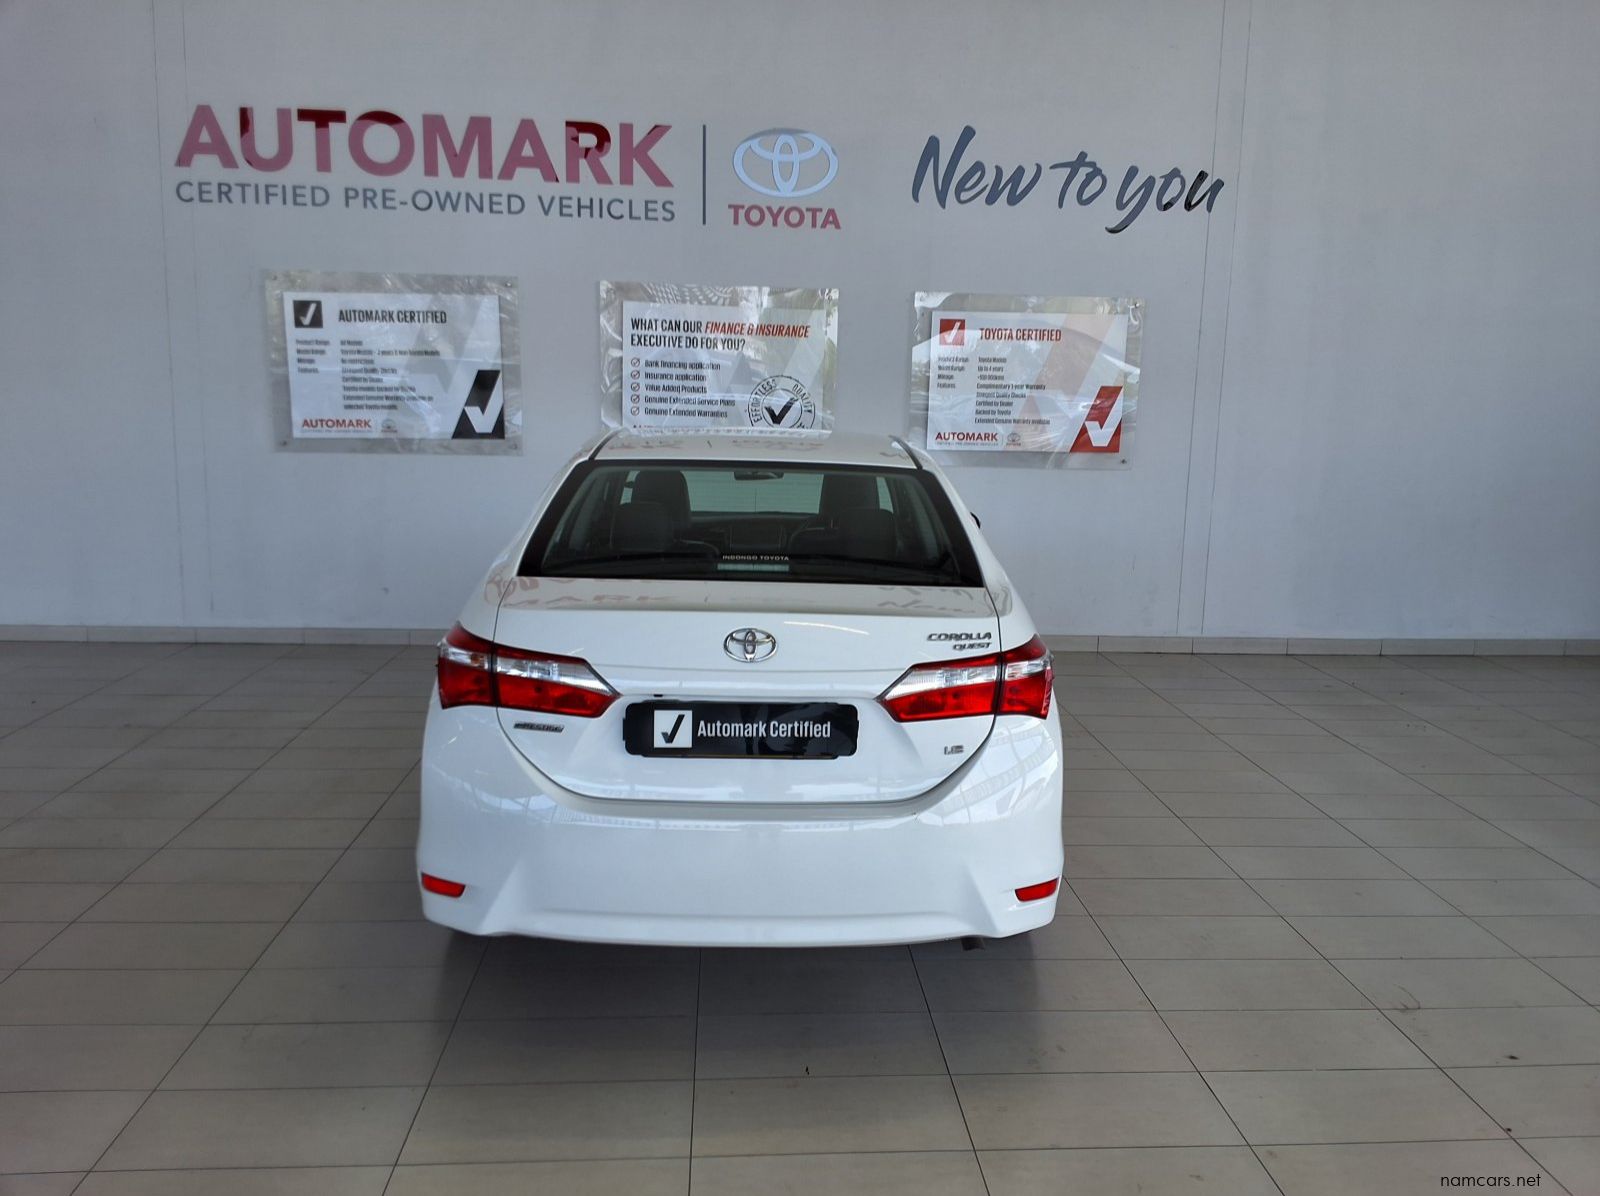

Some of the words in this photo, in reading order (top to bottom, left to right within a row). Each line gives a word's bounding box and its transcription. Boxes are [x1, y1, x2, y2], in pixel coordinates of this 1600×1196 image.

[174, 104, 674, 187] AUTOMARK
[912, 125, 1042, 209] New
[1049, 150, 1107, 209] to
[1105, 165, 1224, 233] you
[176, 181, 329, 207] CERTIFIED
[344, 187, 526, 215] PRE-OWNED
[538, 194, 675, 222] VEHICLES
[728, 204, 841, 230] TOYOTA
[338, 309, 395, 323] AUTOMARK
[397, 310, 447, 324] CERTIFIED
[631, 317, 659, 330] WHAT
[661, 318, 681, 332] CAN
[683, 319, 702, 333] OUR
[704, 321, 746, 335] FINANCE
[747, 323, 753, 336] &
[755, 323, 810, 338] INSURANCE
[979, 328, 1014, 341] TOYOTA
[1015, 328, 1062, 342] CERTIFIED
[631, 334, 682, 349] EXECUTIVE
[685, 336, 698, 349] DO
[700, 336, 718, 350] FOR
[720, 338, 746, 351] YOU?
[644, 360, 659, 368] Bank
[660, 361, 687, 370] financing
[688, 362, 720, 371] application
[644, 372, 673, 380] Insurance
[674, 373, 706, 382] application
[681, 385, 707, 394] Products
[669, 408, 696, 417] Extended
[302, 418, 371, 429] AUTOMARK
[935, 432, 998, 442] AUTOMARK
[927, 632, 992, 642] COROLLA
[953, 642, 992, 651] QUEST
[697, 719, 767, 738] Automark
[769, 719, 831, 738] Certified
